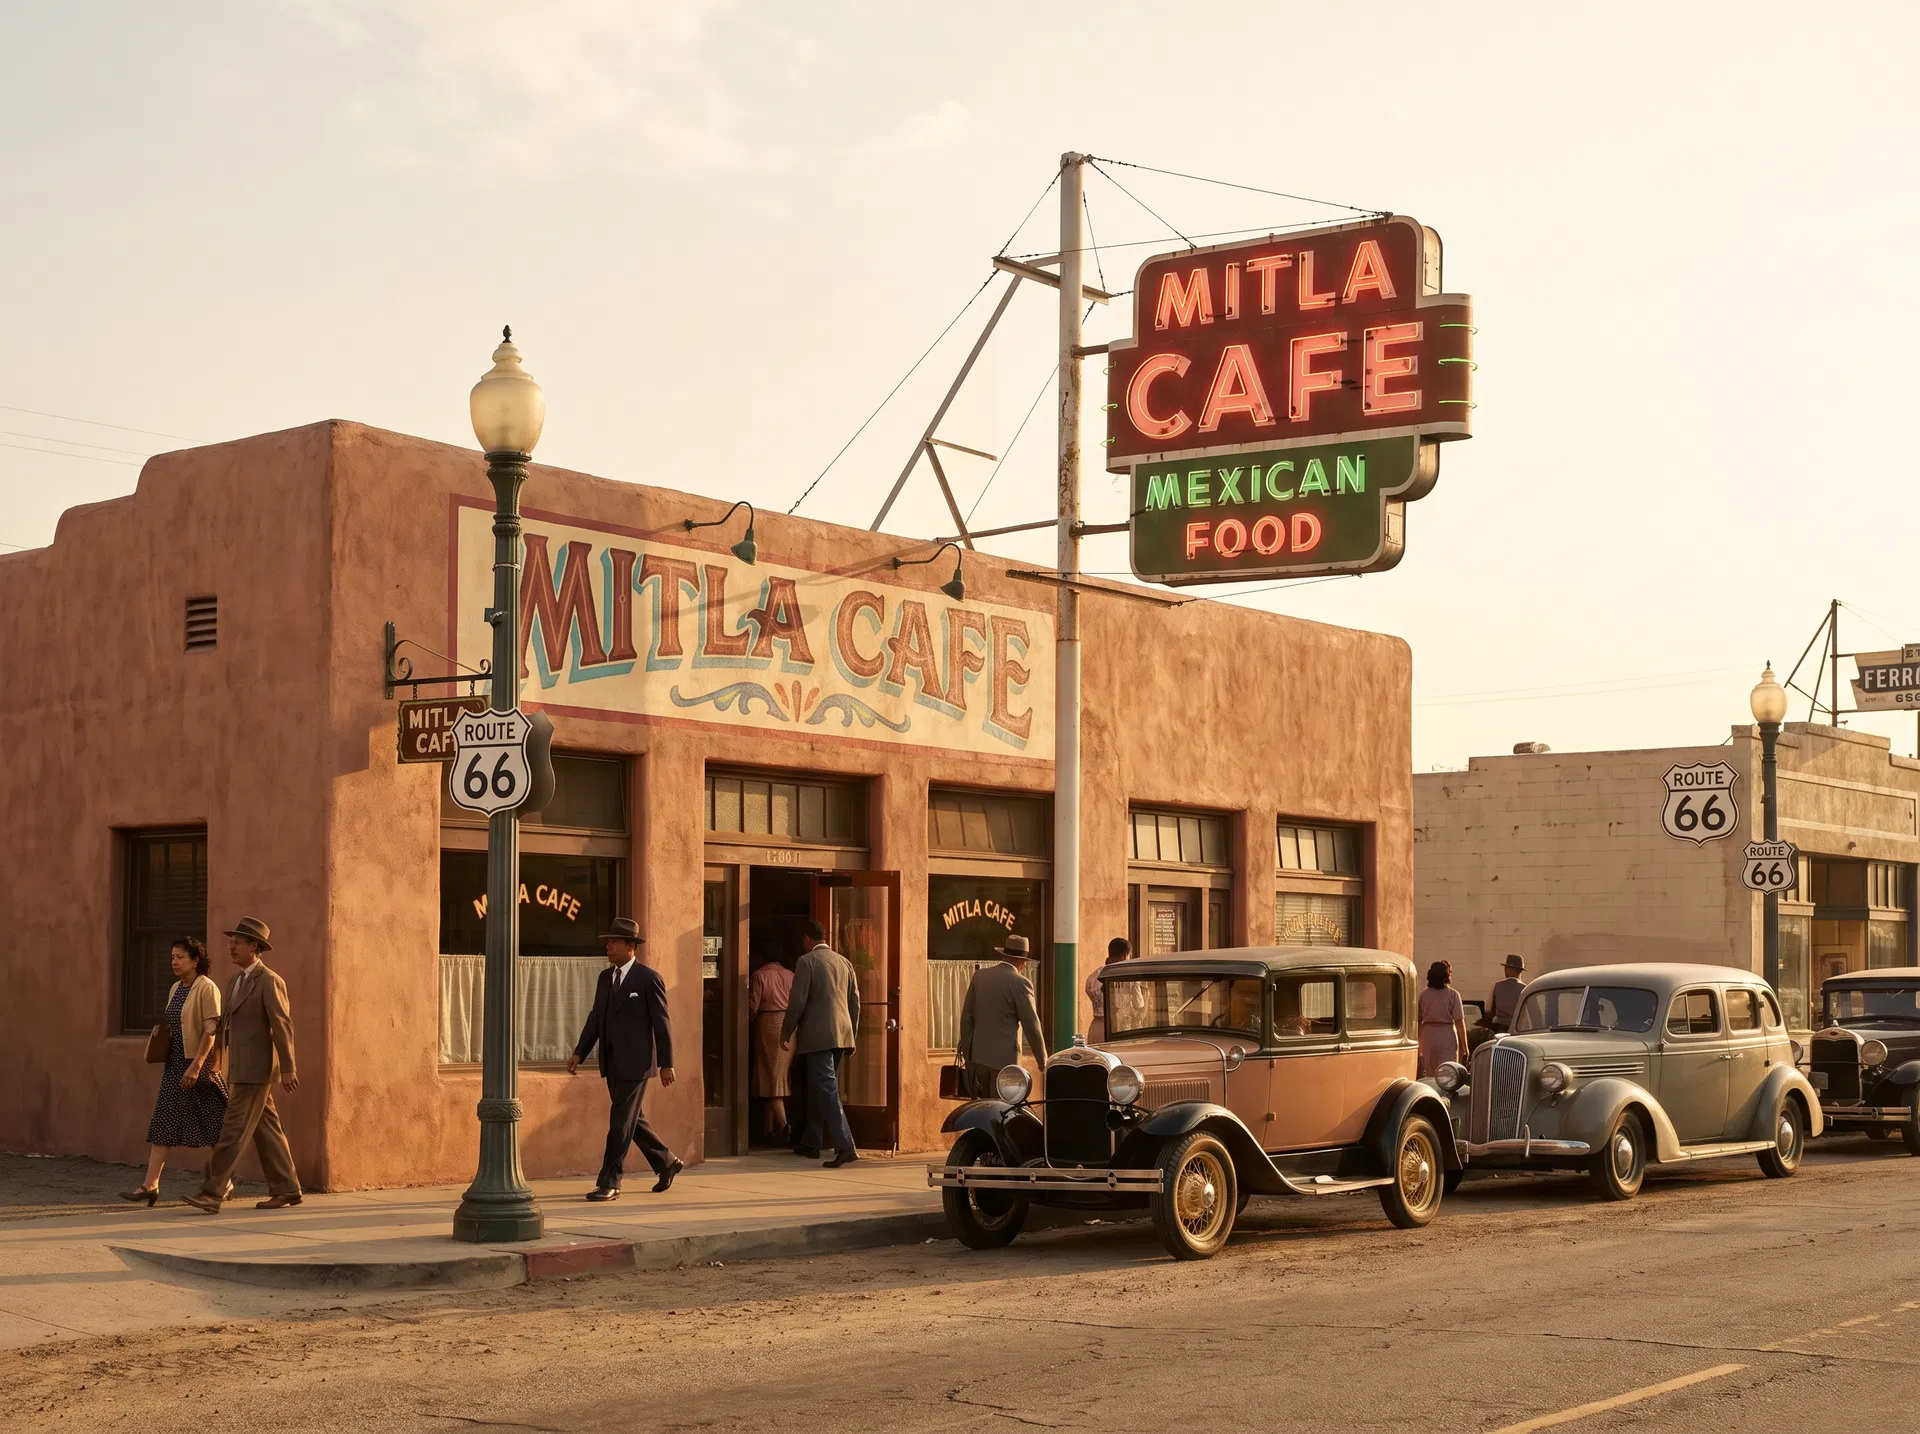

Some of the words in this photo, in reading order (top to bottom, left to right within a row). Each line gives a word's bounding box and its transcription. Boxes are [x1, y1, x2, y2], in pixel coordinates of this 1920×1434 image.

[1154, 239, 1397, 331] MITLA
[1126, 321, 1423, 440] CAFE
[1145, 454, 1366, 511] MEXICAN
[1186, 512, 1322, 560] FOOD
[518, 533, 814, 685] MITLA
[832, 590, 1032, 747] CAFE
[416, 731, 456, 754] CAF
[465, 722, 516, 741] ROUTE
[463, 751, 516, 799] 66
[1674, 771, 1724, 787] ROUTE
[1674, 793, 1726, 832] 66
[1750, 846, 1785, 857] ROUTE
[1751, 861, 1784, 886] 66
[536, 884, 582, 921] CAFE
[943, 899, 982, 930] MITLA
[984, 900, 1016, 931] CAFE
